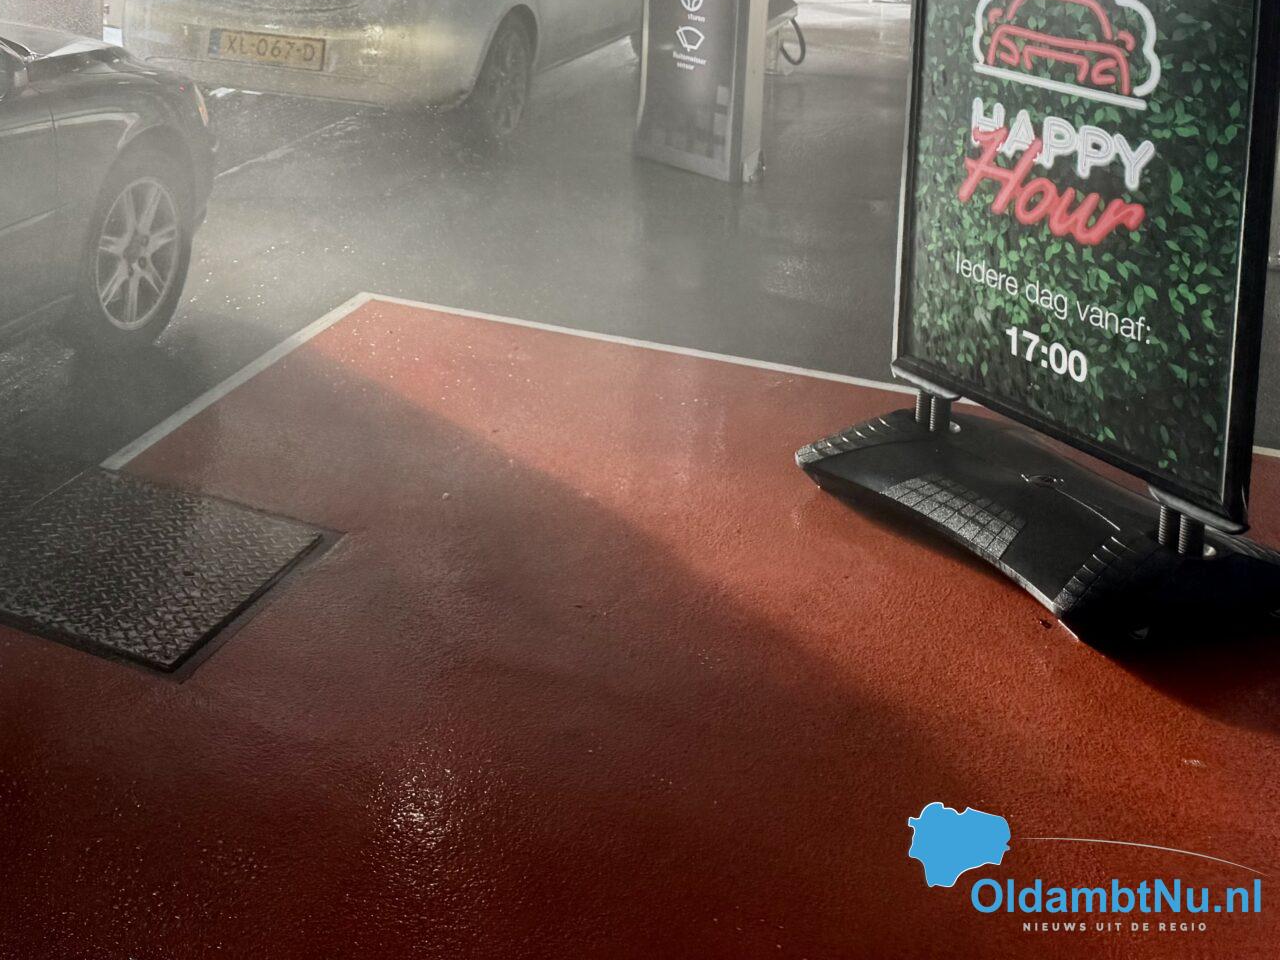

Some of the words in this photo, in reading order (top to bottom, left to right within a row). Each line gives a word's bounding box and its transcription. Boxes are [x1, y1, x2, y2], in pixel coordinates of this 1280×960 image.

[226, 34, 315, 62] XL-067-D
[959, 127, 1146, 245] Hour
[972, 97, 1156, 191] HAPPY
[955, 250, 1018, 296] Iedere
[1025, 280, 1068, 320] dag
[1076, 300, 1151, 345] vanaf:
[1005, 326, 1088, 383] 17:00
